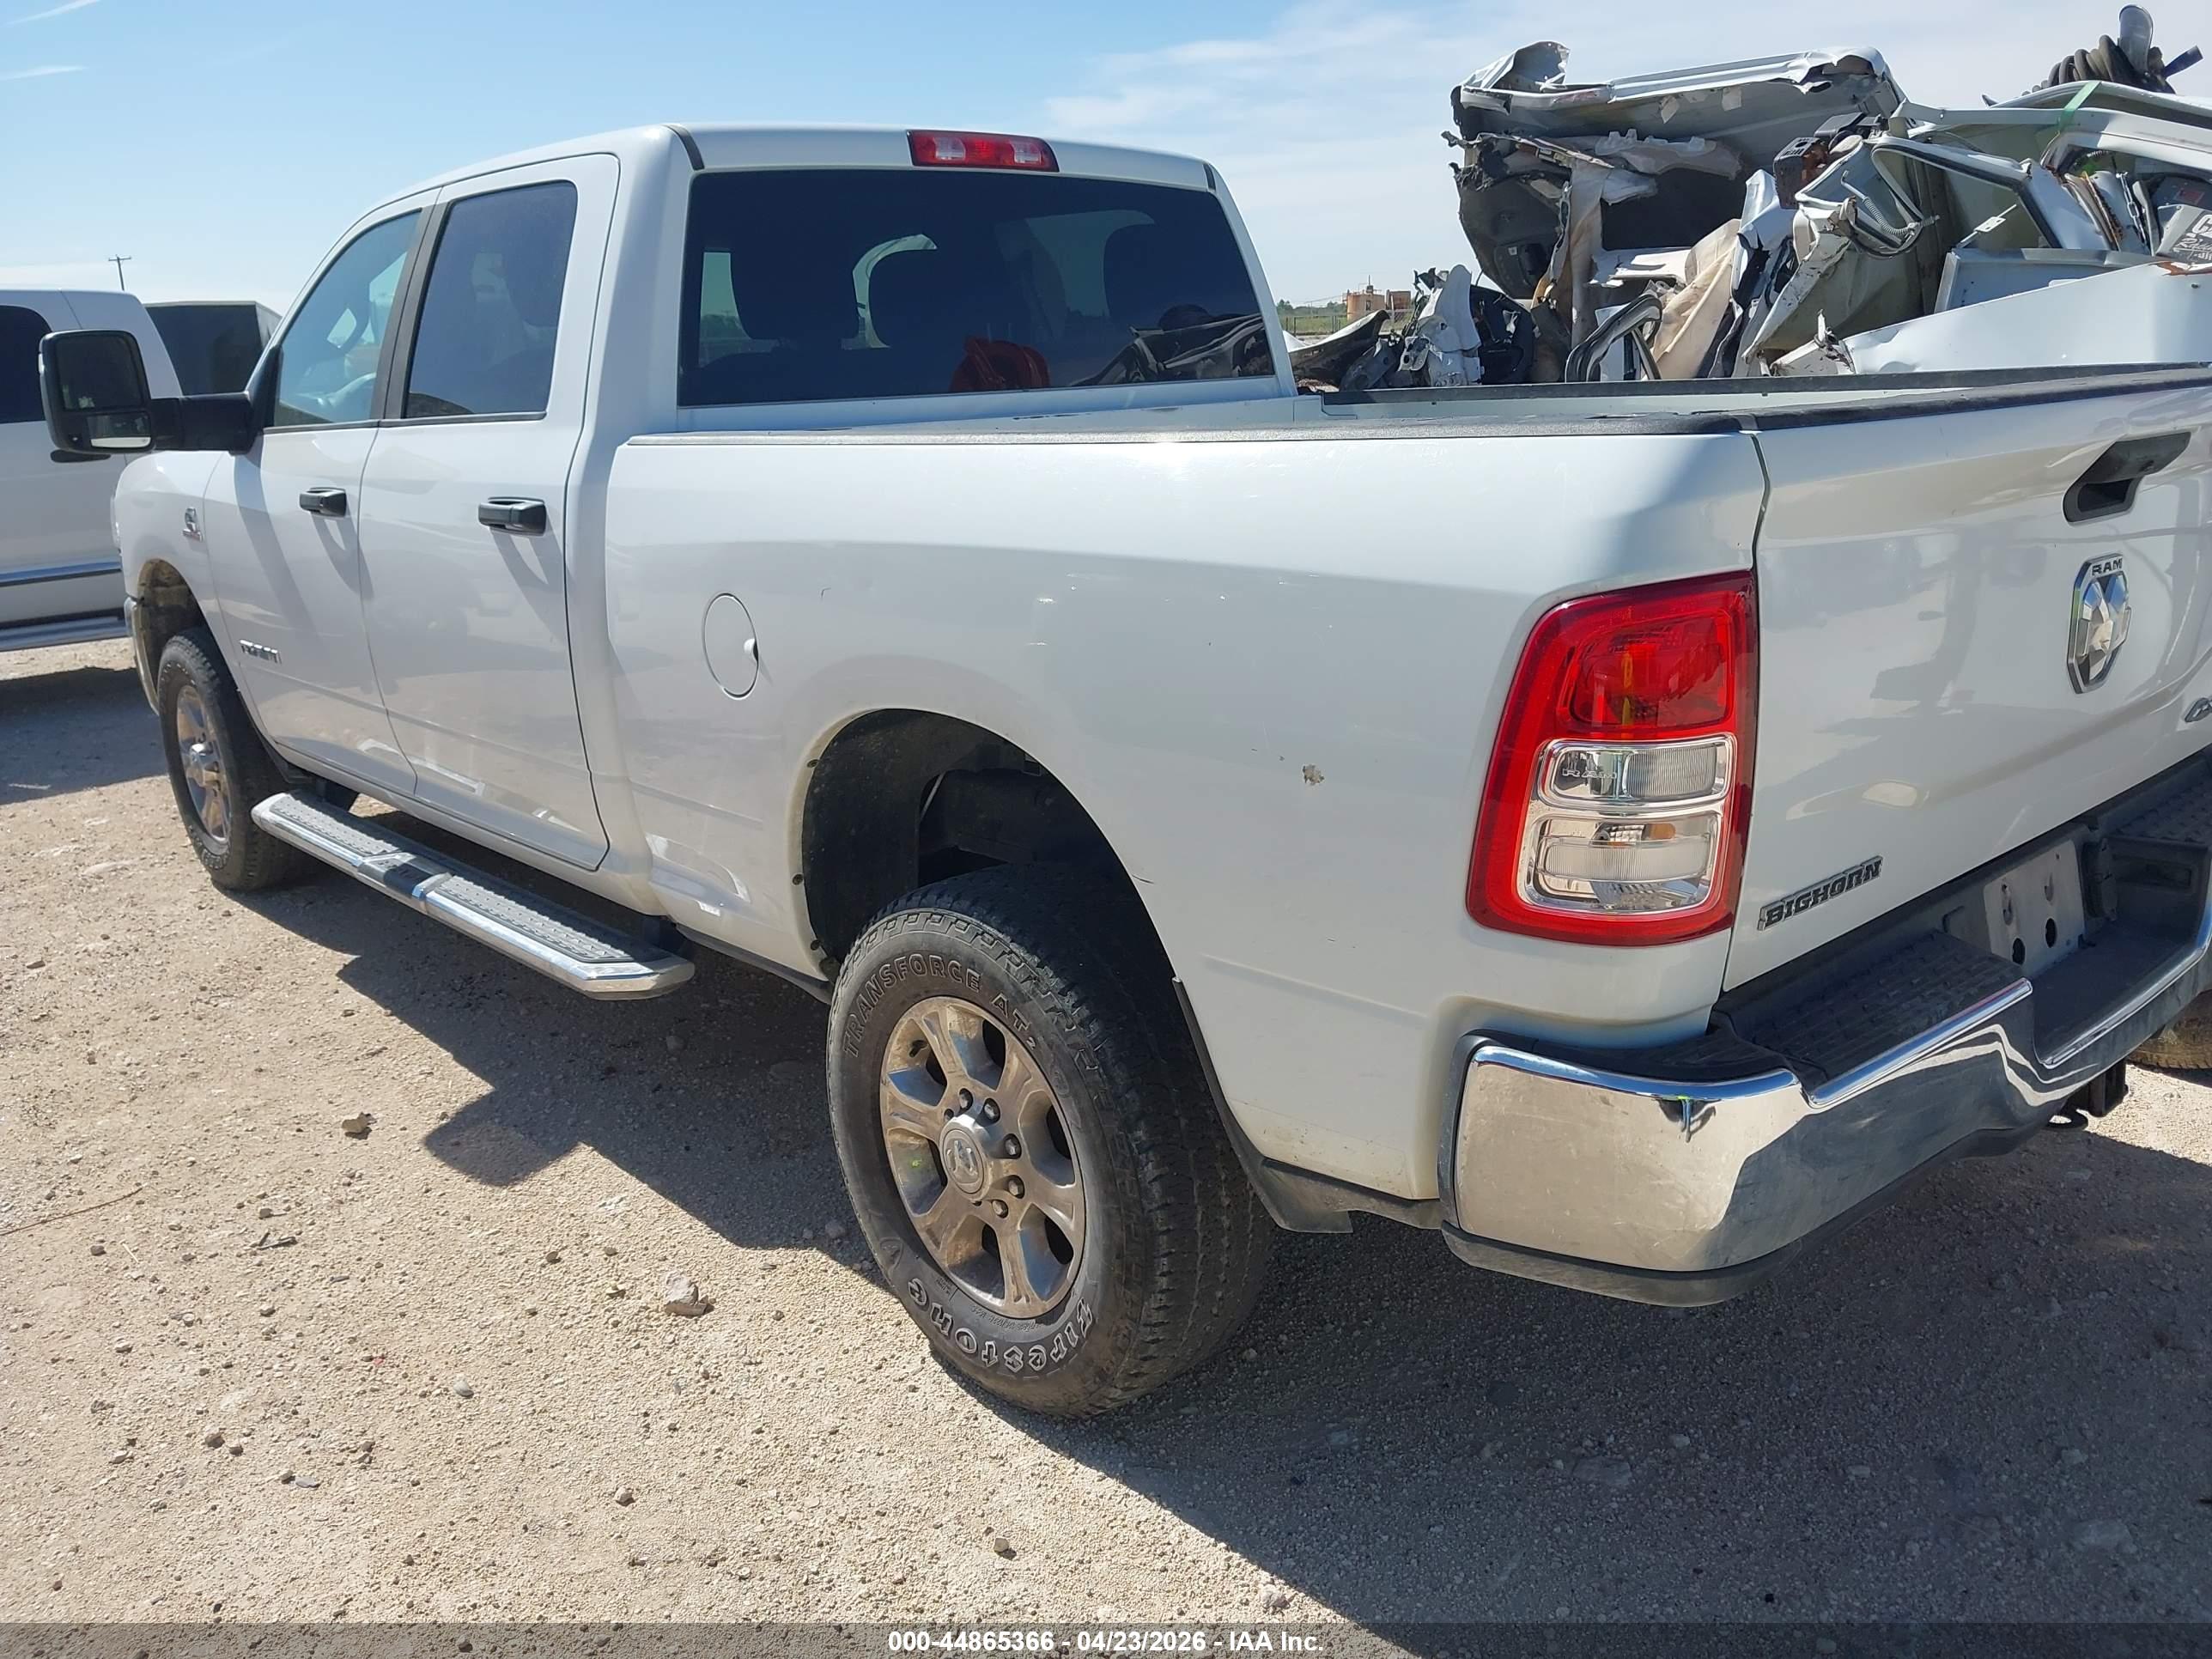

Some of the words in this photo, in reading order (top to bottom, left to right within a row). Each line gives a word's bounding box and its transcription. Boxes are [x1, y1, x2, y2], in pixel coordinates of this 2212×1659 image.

[2091, 557, 2123, 576] RAM
[1561, 768, 1617, 781] RAM
[1759, 857, 1883, 929] BIGHORN
[842, 953, 982, 1058] TRANSFORCE
[907, 1277, 1093, 1373] Firestone
